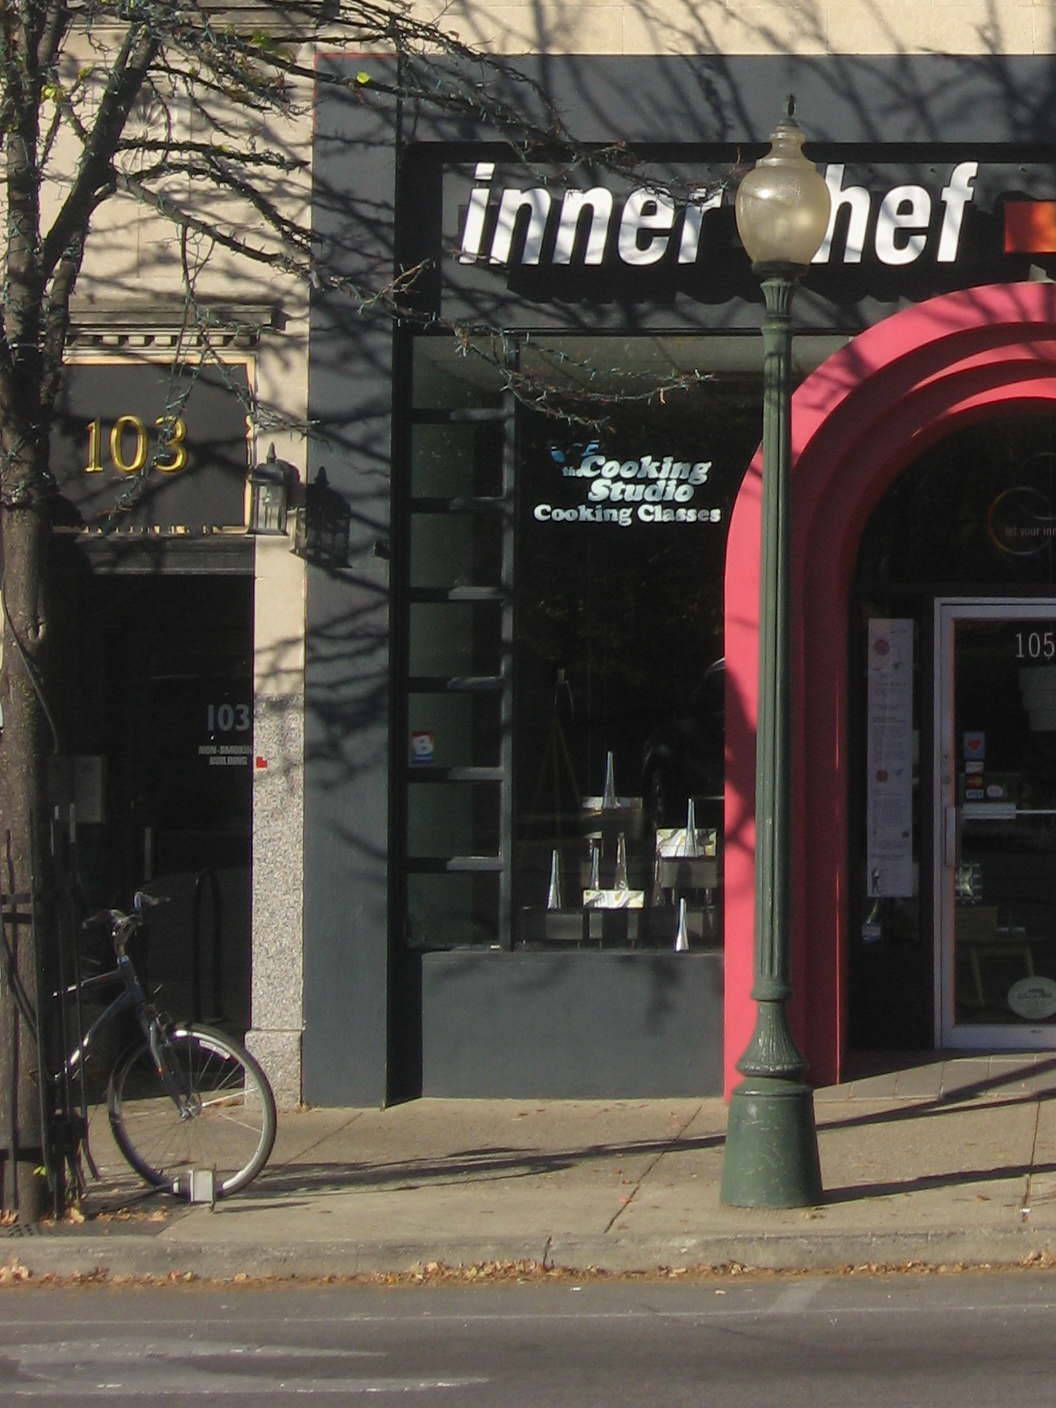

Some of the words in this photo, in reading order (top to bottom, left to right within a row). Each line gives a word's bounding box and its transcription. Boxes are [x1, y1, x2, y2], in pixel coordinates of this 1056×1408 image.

[458, 161, 725, 265] inner
[811, 161, 979, 266] hef
[84, 414, 188, 473] 103
[562, 466, 583, 478] the
[581, 455, 712, 485] Cooking
[587, 478, 694, 503] Studio
[533, 503, 633, 527] Cooking
[637, 503, 722, 523] Classes
[1020, 527, 1040, 539] your
[1015, 632, 1055, 658] 105
[207, 703, 250, 731] 103
[198, 745, 253, 755] NON-SMOKIN
